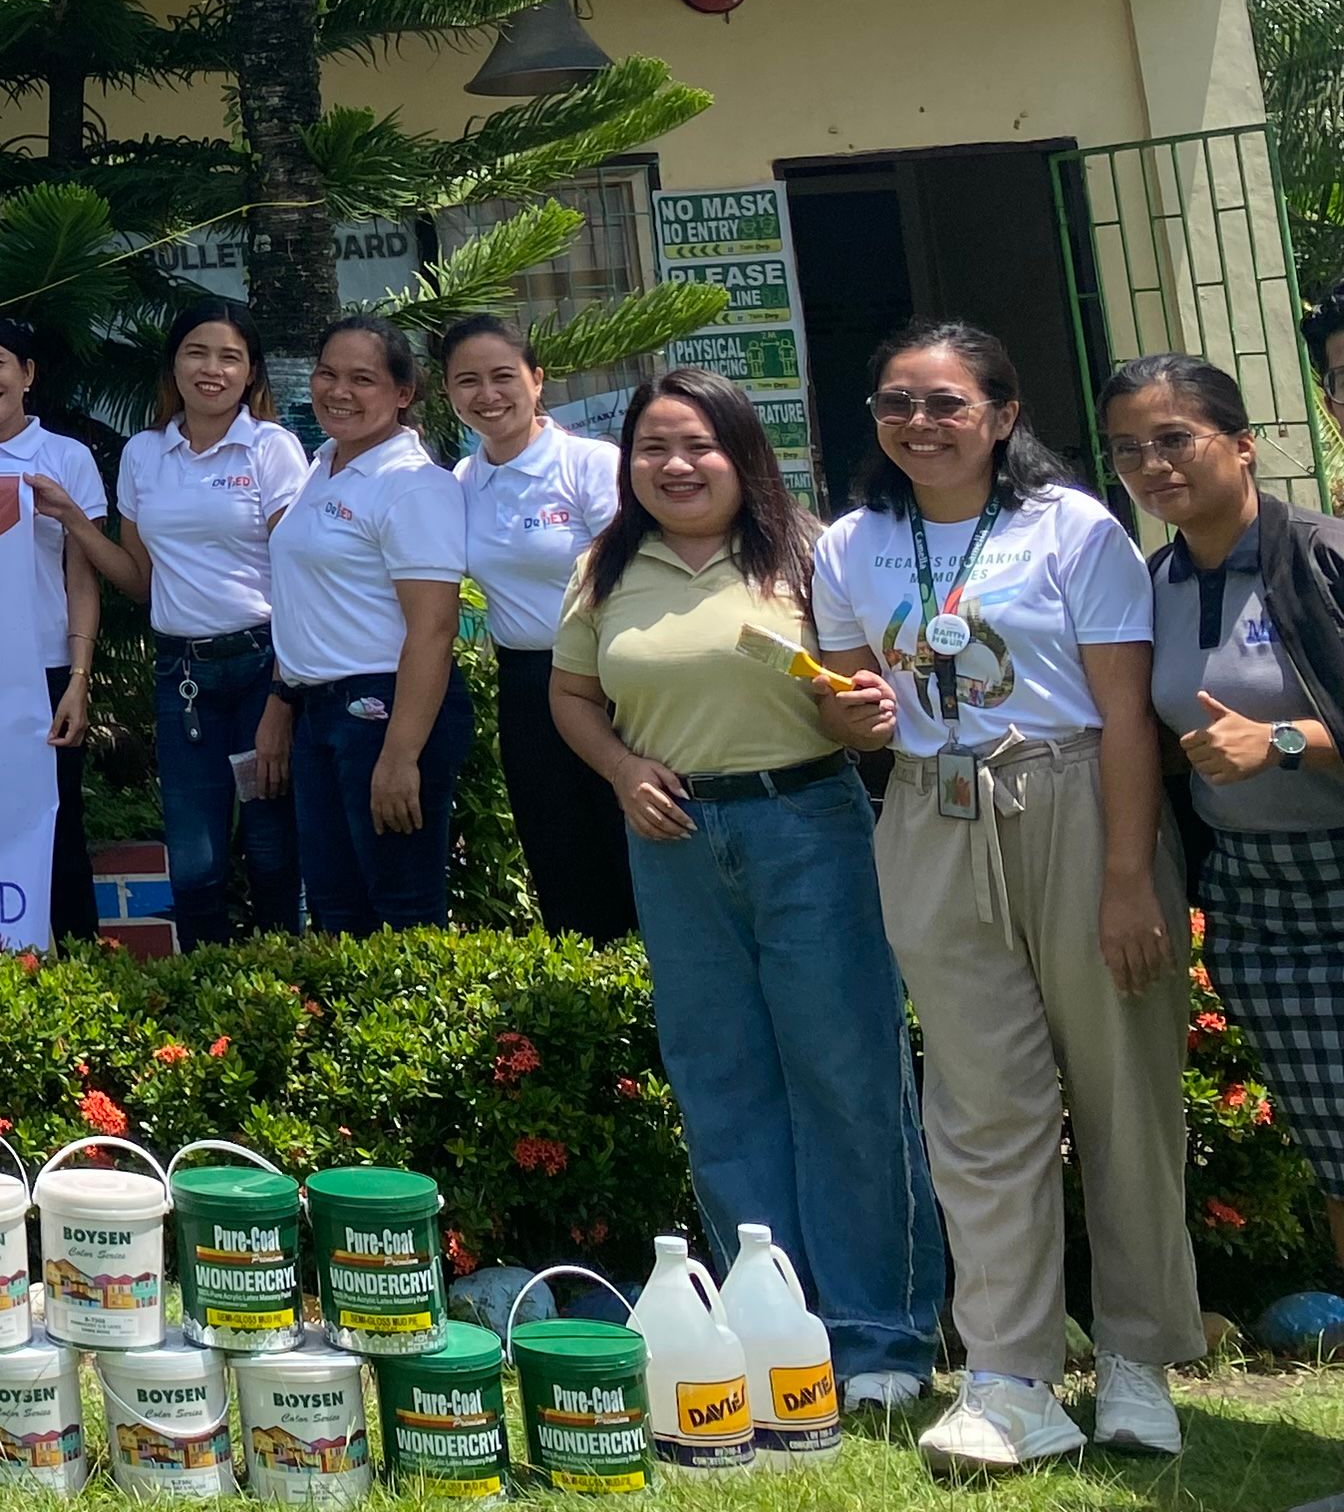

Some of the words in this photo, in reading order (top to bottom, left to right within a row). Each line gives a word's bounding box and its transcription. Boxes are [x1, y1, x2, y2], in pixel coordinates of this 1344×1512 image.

[660, 200, 694, 222] NO
[702, 193, 776, 219] MASK
[687, 219, 740, 243] ENTRY
[676, 338, 746, 362] PHYSICAL
[524, 509, 570, 530] DepED
[63, 1226, 132, 1245] BOYSEN
[213, 1224, 281, 1252] Pure-Coat
[345, 1226, 414, 1256] Pure-Coat
[68, 1247, 94, 1257] Color
[97, 1249, 126, 1259] Series
[195, 1264, 297, 1292] WONDERCRYL
[329, 1266, 435, 1296] WONDERCRYL
[137, 1386, 207, 1403] BOYSEN
[273, 1391, 345, 1408] BOYSEN
[412, 1386, 483, 1416] Pure-Coat
[552, 1384, 625, 1414] Pure-Coat
[23, 1408, 52, 1418] Series
[144, 1408, 173, 1419] Color
[175, 1407, 203, 1418] Series
[281, 1413, 309, 1424] Color
[312, 1413, 341, 1423] Series
[395, 1426, 502, 1457] WONDERCRYL
[537, 1424, 647, 1455] WONDERCRYL
